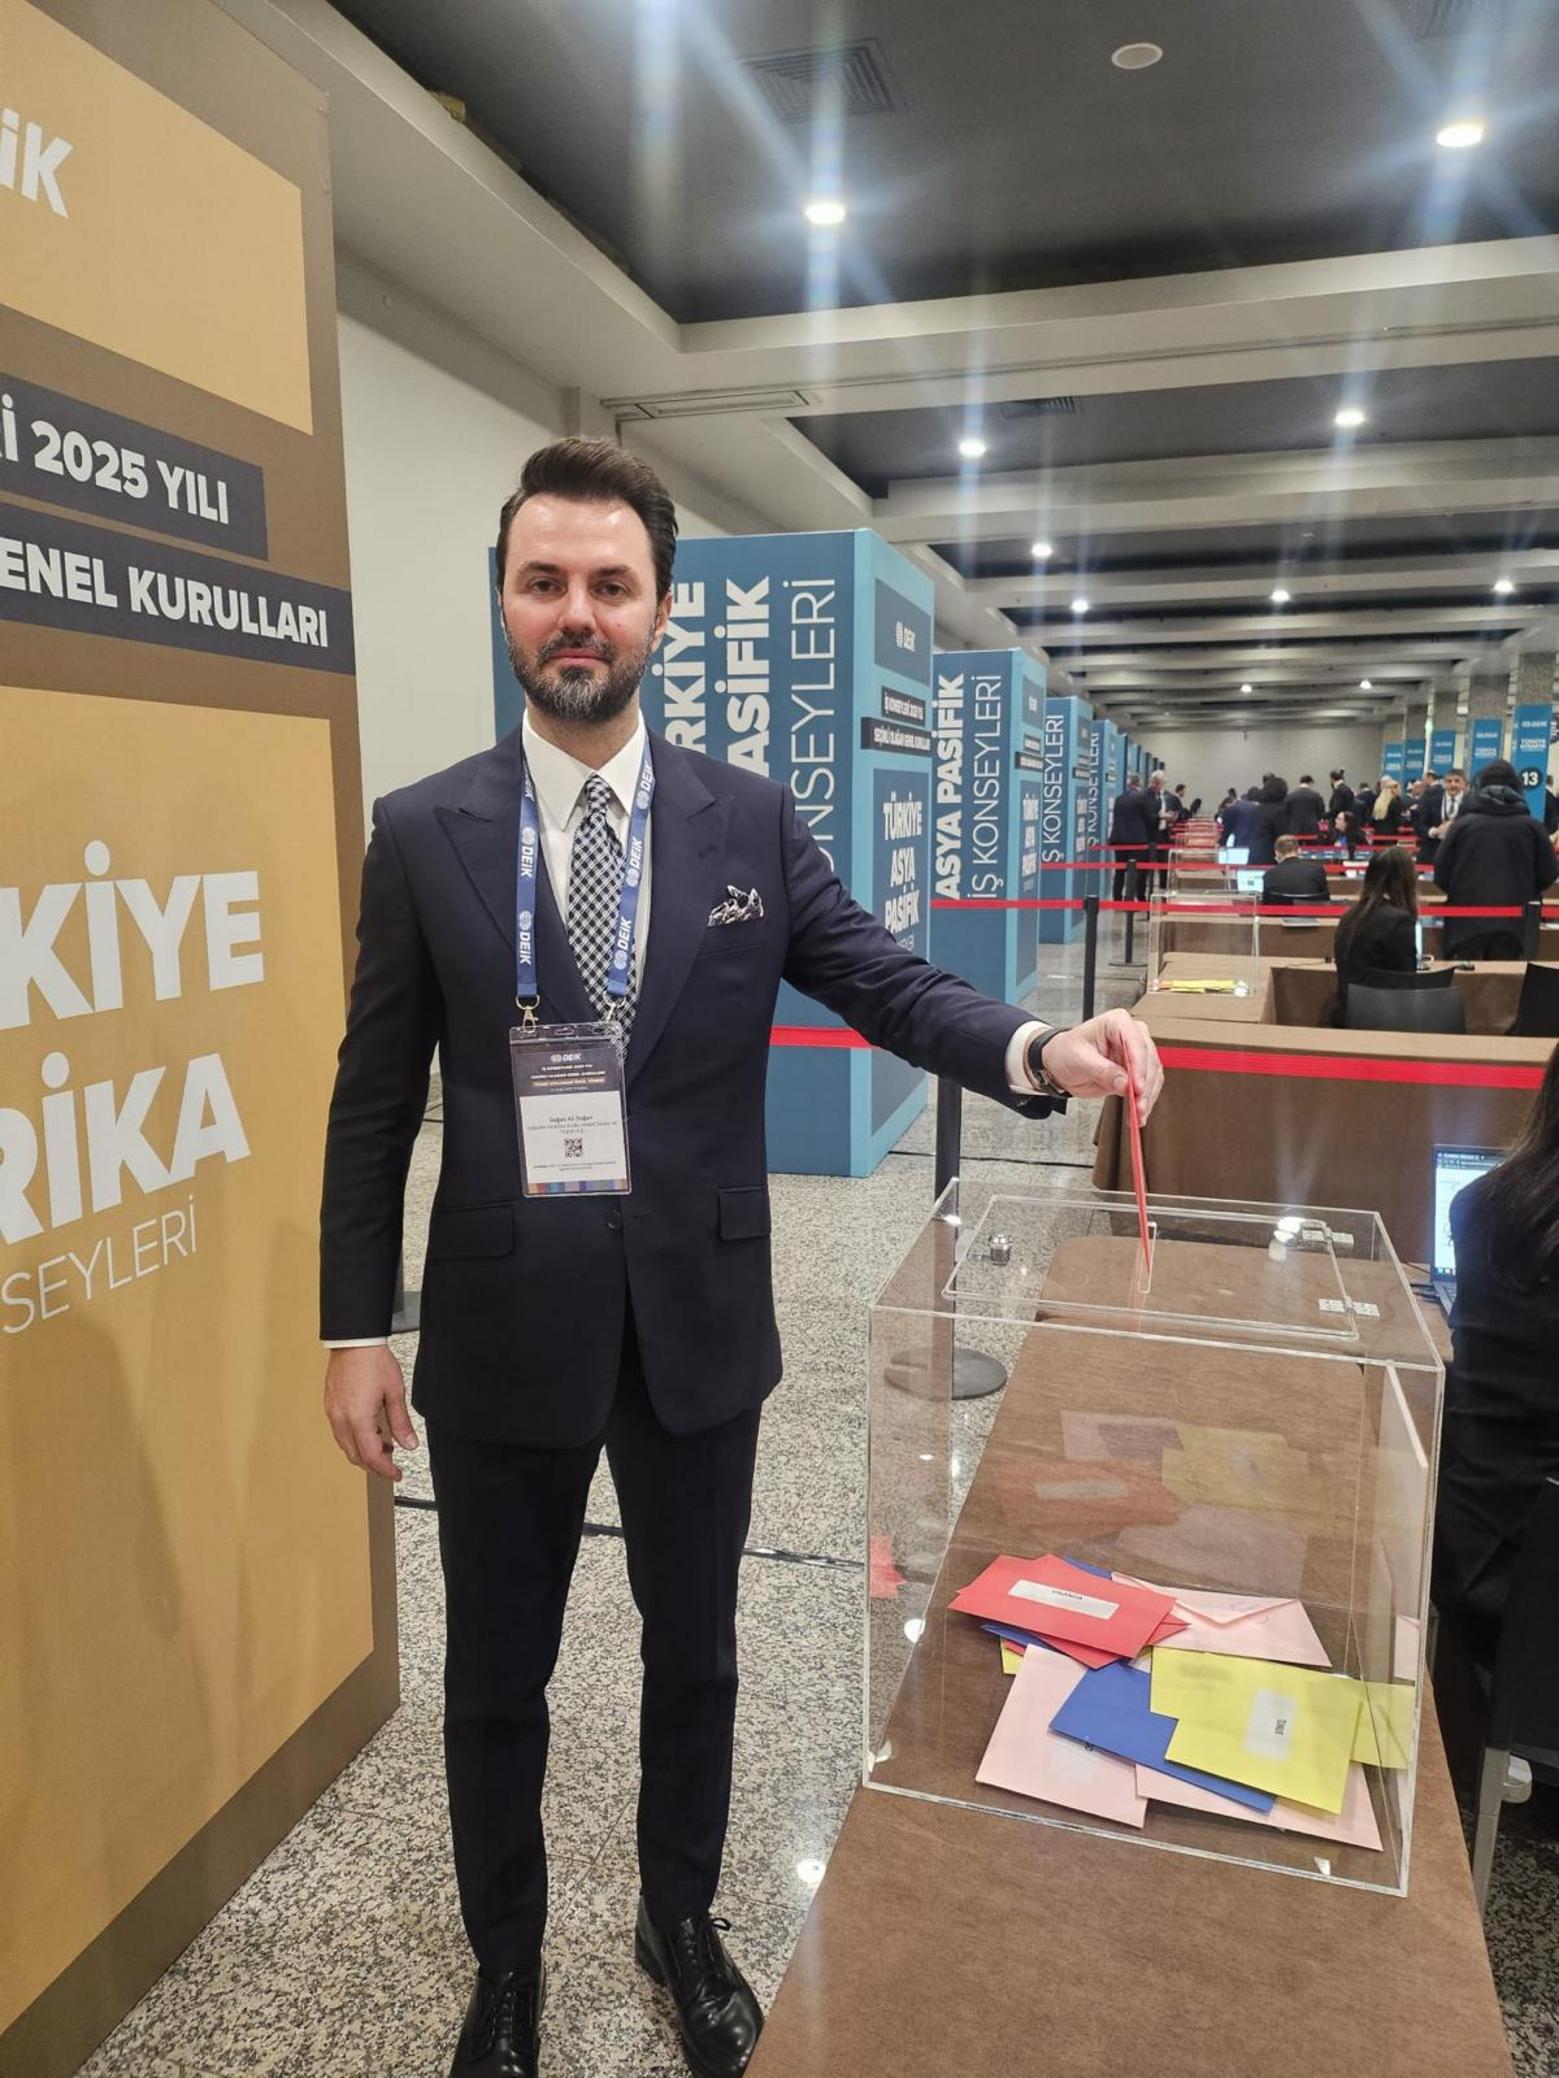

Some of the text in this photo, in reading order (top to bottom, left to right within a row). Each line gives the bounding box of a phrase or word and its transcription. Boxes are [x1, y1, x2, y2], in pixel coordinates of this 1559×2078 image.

[0, 393, 229, 525] İ 2025 YILI
[0, 536, 328, 648] ENEL KURULLARI
[783, 578, 834, 872] NSEYLERİ
[931, 673, 964, 900] ASYA PASİFİK
[967, 675, 1003, 899] İŞ KONSEYLERİ
[1522, 771, 1539, 786] 13
[883, 791, 922, 840] TÜRKİYE
[890, 847, 916, 887] ASYA
[0, 840, 264, 1030] KİYE
[2, 1194, 197, 1335] SEYLERİ
